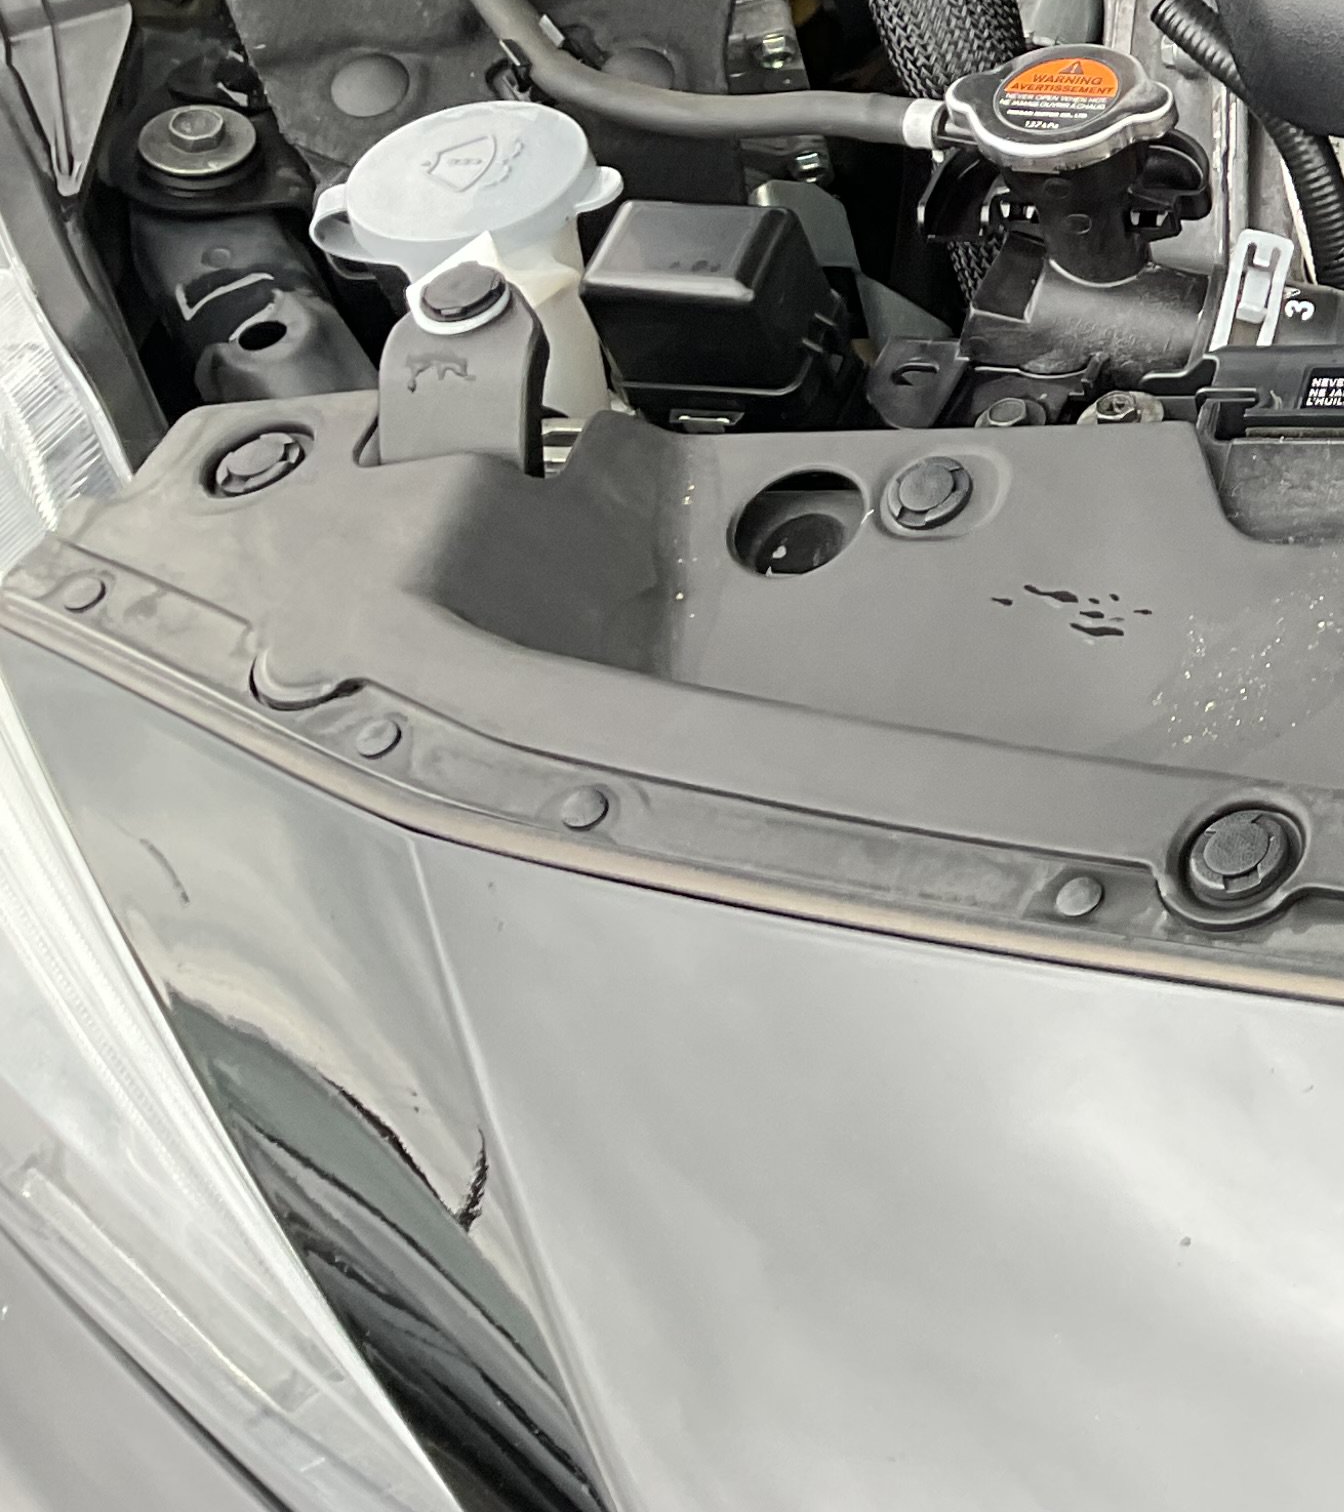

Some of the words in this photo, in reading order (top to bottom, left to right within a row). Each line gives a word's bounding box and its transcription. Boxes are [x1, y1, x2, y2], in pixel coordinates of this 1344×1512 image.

[1033, 74, 1103, 86] WARNING
[1011, 83, 1114, 95] AVERTISSEMENT
[1284, 301, 1315, 321] 3
[1309, 388, 1326, 397] NE
